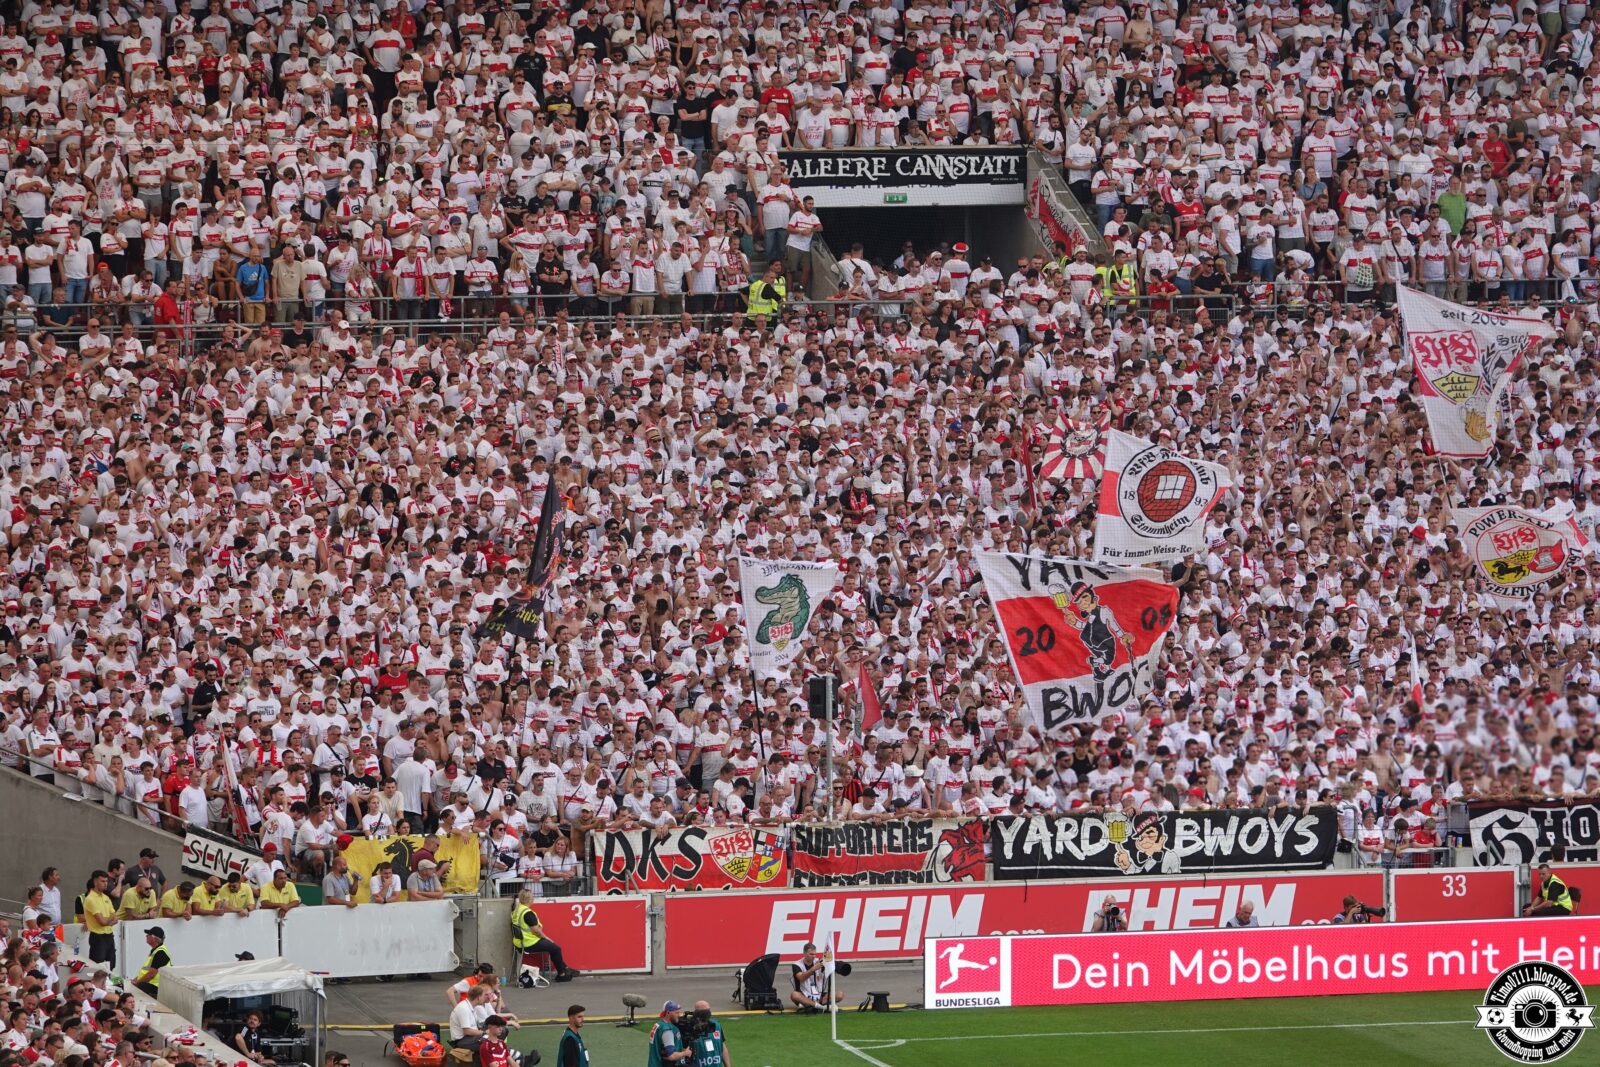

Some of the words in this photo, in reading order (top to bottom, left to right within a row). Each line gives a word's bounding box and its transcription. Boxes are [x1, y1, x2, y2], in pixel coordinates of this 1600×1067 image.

[895, 154, 1020, 180] CANNSTATT
[1123, 490, 1136, 501] 18
[1130, 513, 1191, 535] Stammheim
[1102, 546, 1122, 558] Für
[1124, 547, 1152, 558] immer
[1015, 623, 1056, 657] 20
[996, 815, 1112, 861] YARD
[1173, 813, 1320, 858] BWOYS
[601, 826, 708, 882] DKS
[1442, 874, 1467, 898] 33
[570, 903, 597, 928] 32
[765, 893, 985, 955] EHEIM
[1082, 883, 1297, 932] EHEIM
[1052, 951, 1150, 990] Dein
[1169, 944, 1409, 986] Möbelhaus
[1427, 938, 1500, 977] mit
[935, 996, 1001, 1008] BUNDESLIGA
